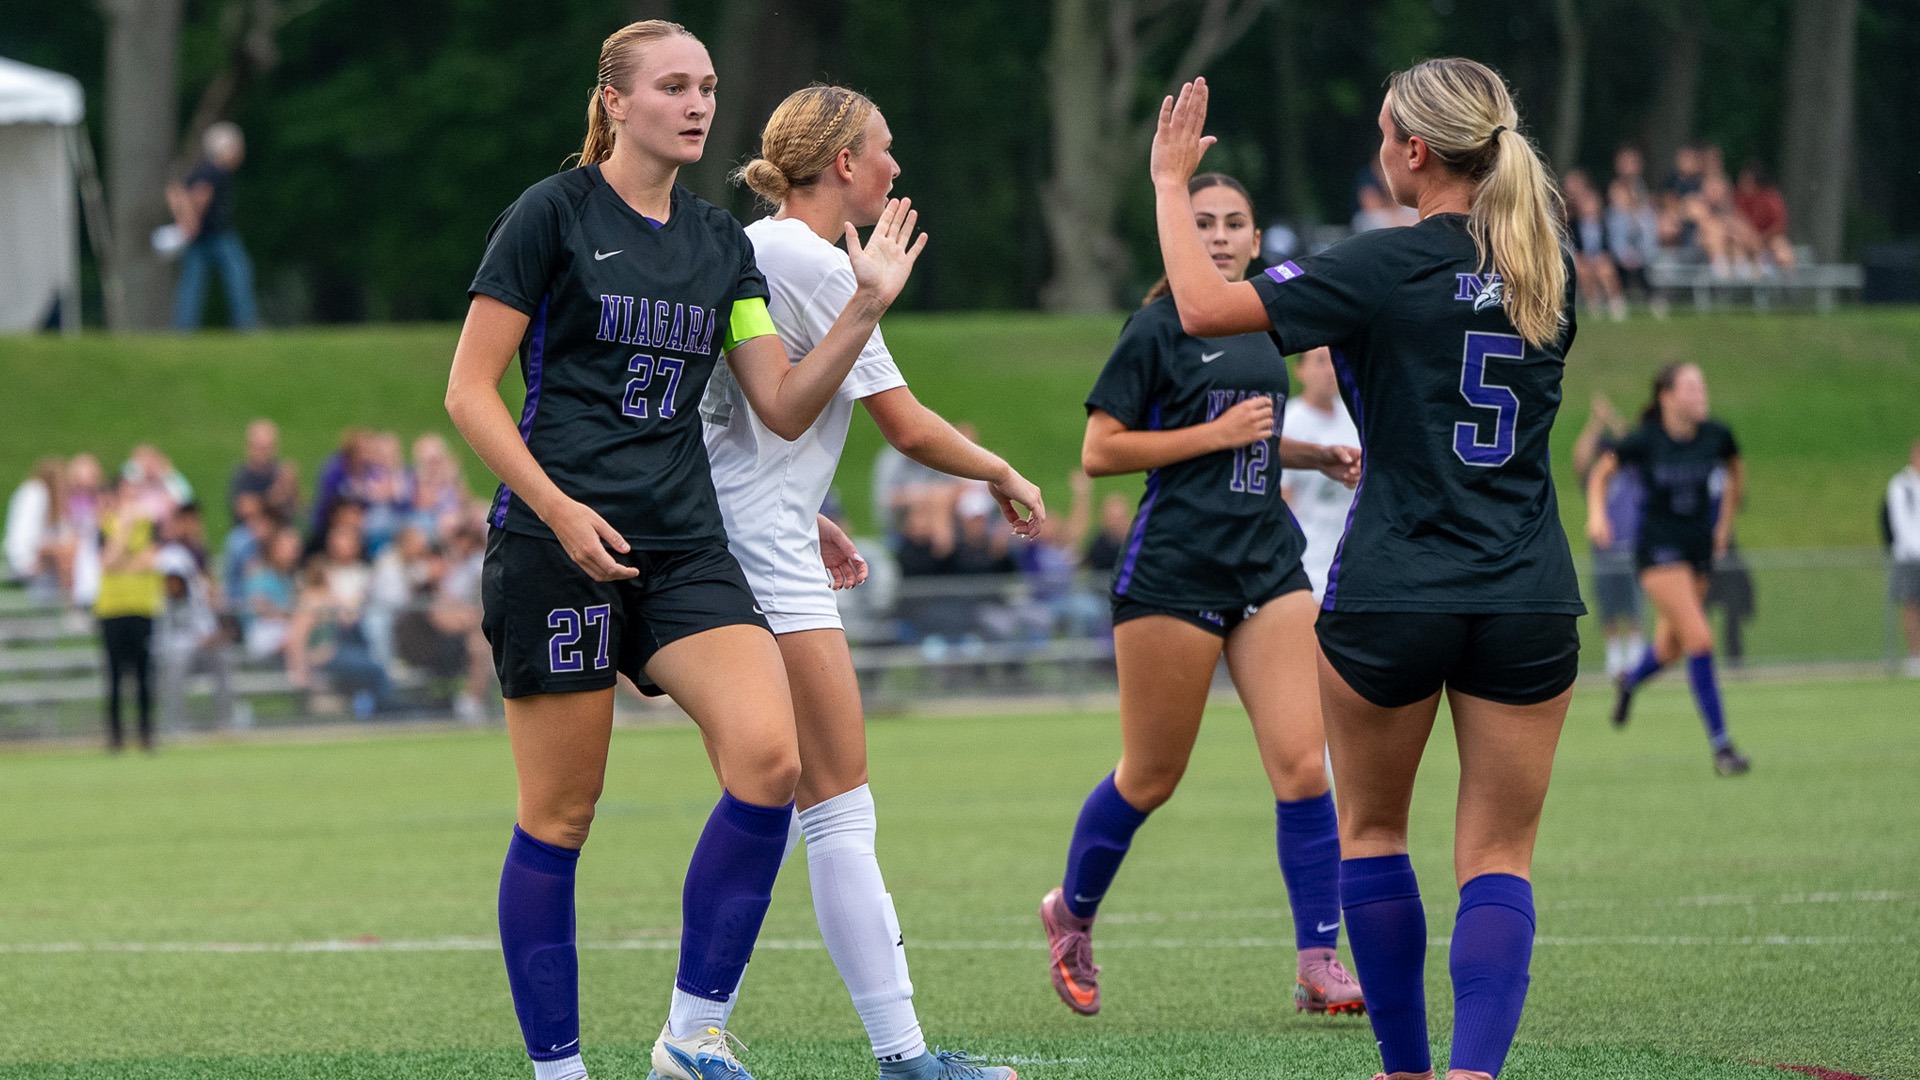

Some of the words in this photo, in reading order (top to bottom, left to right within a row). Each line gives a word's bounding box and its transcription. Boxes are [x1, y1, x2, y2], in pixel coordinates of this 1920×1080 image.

[596, 294, 716, 355] NIAGARA
[622, 353, 685, 419] 27
[1453, 330, 1525, 467] 5
[1229, 440, 1269, 495] 12
[547, 603, 610, 673] 27
